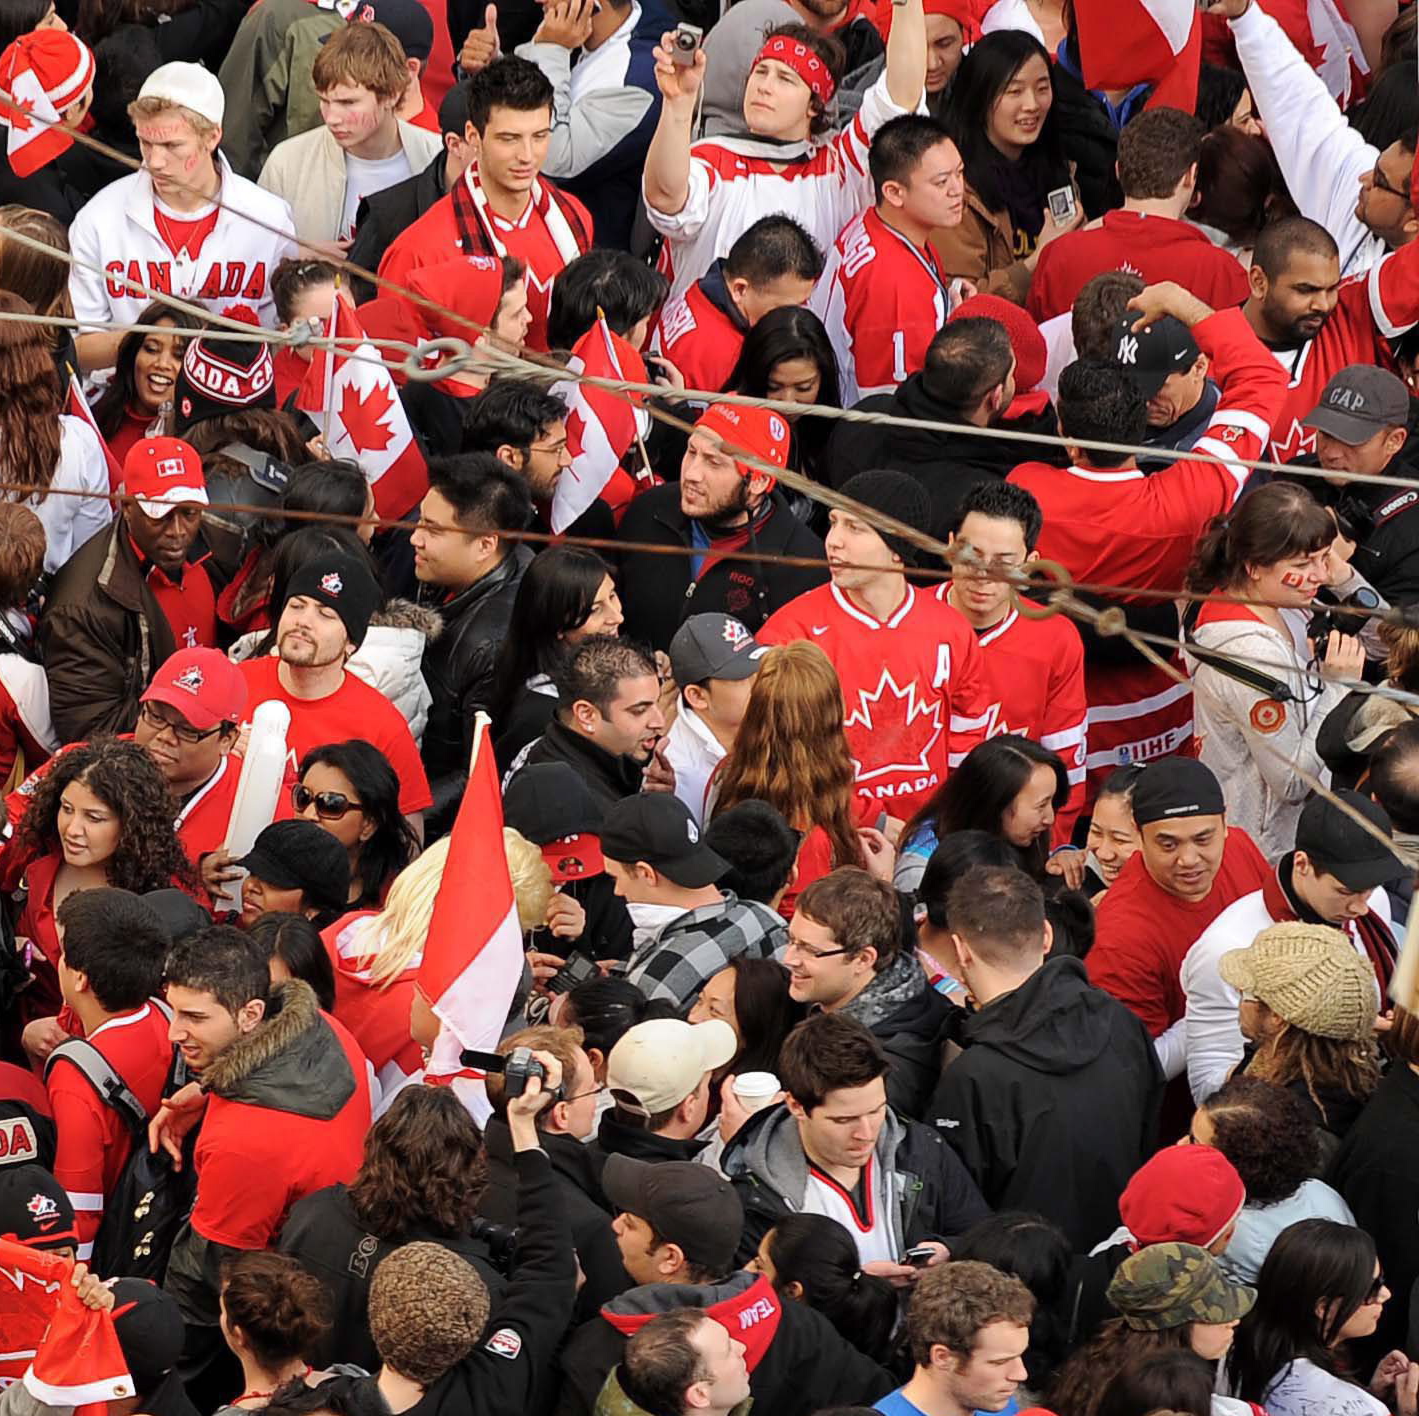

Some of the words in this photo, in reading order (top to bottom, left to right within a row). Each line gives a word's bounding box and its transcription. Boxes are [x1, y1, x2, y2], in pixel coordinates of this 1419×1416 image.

[106, 261, 265, 300] CANADA
[893, 331, 907, 382] 1
[1330, 387, 1365, 411] GAP
[932, 643, 951, 688] A
[1132, 733, 1176, 760] IIHF
[739, 1296, 777, 1330] TEAM
